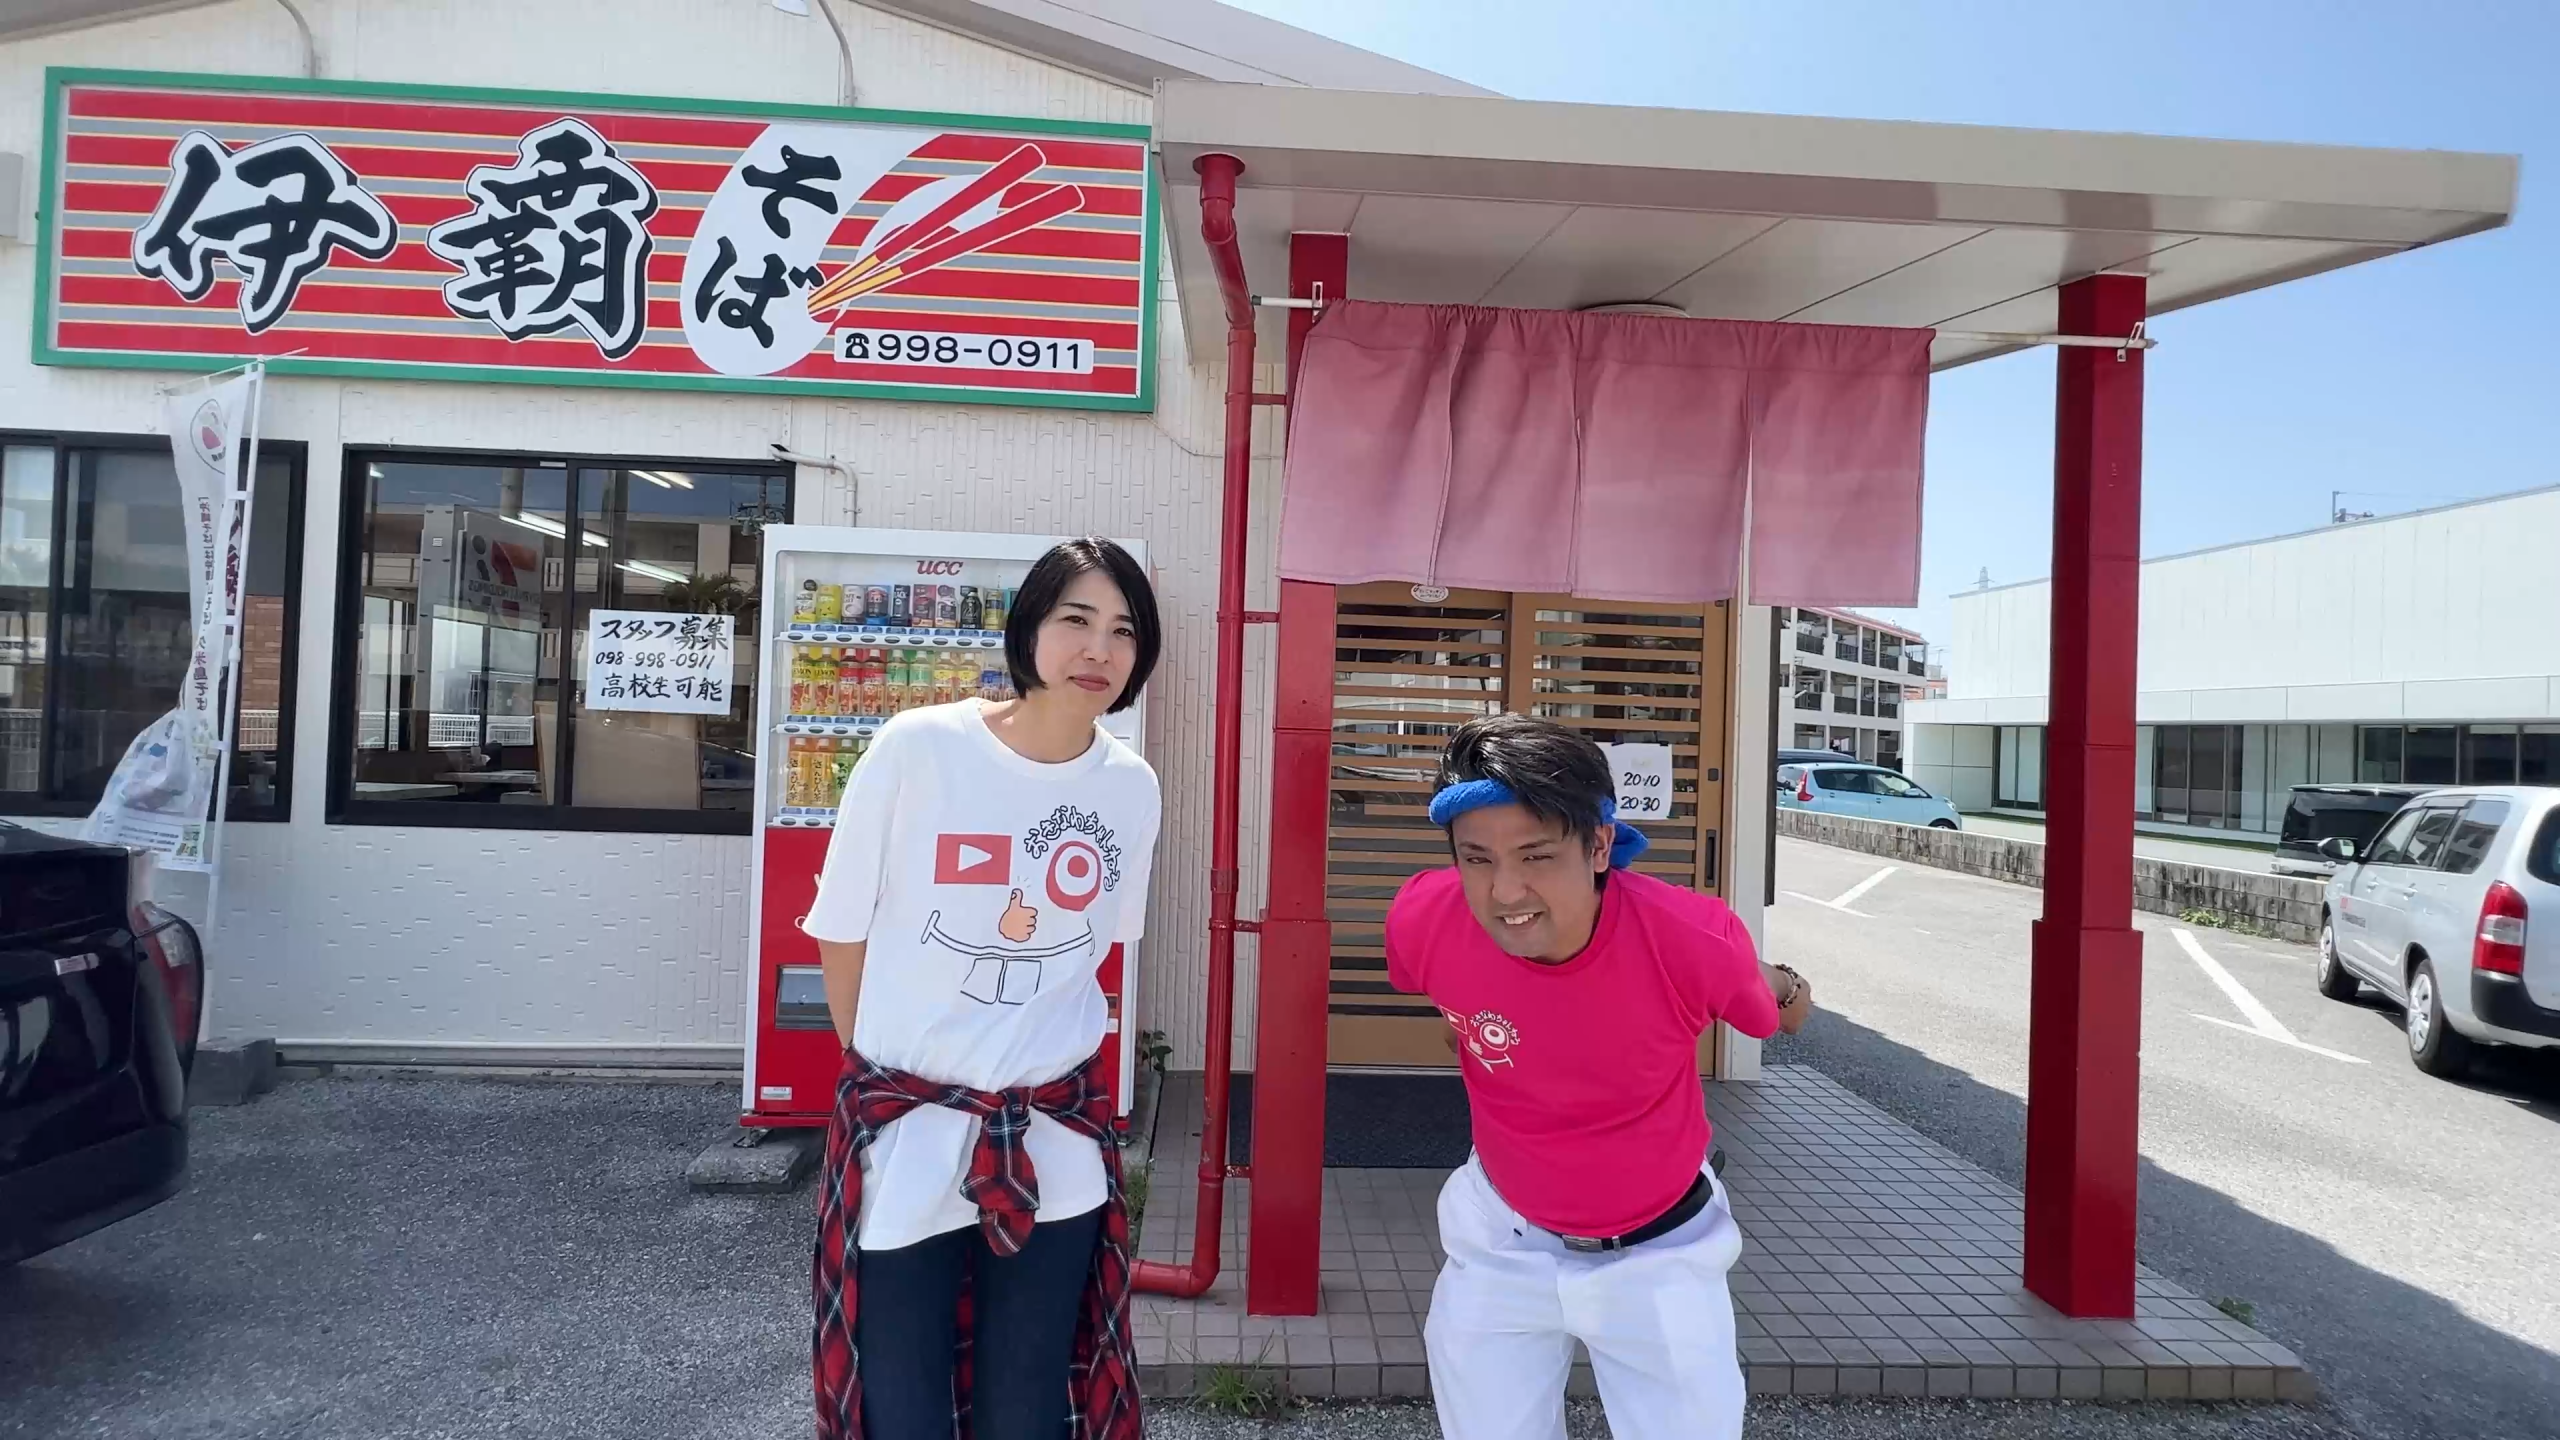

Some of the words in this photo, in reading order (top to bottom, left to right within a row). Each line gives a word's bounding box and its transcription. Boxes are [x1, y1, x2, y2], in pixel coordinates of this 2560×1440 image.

[133, 116, 660, 362] 伊覇
[695, 145, 841, 349] そば
[878, 333, 1079, 370] 998-0911
[598, 615, 729, 651] スタッフ募集
[595, 651, 715, 670] 098-998-0911
[600, 673, 723, 702] 高校生可能
[1024, 805, 1122, 892] おきなわちゃんねる
